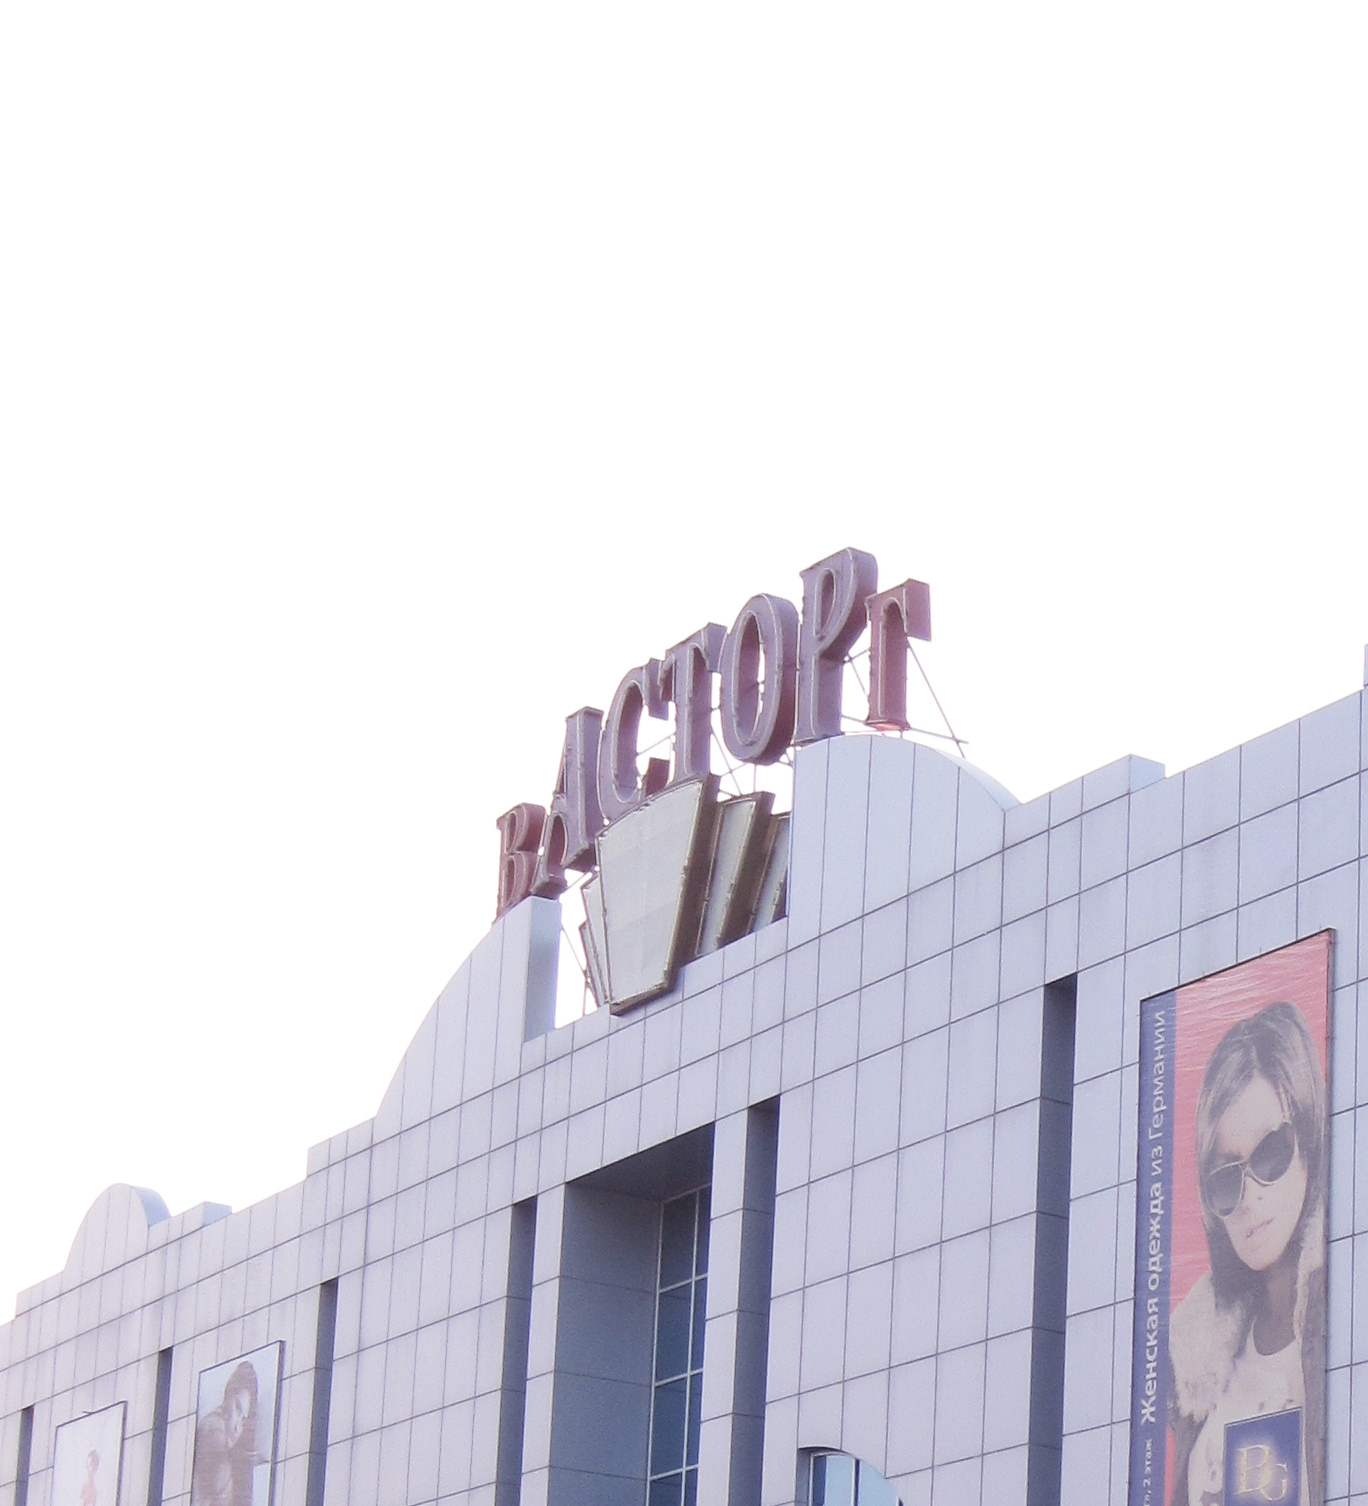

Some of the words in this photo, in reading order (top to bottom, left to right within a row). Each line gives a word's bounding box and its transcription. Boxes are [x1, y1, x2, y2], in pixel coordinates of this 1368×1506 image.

[1148, 1010, 1166, 1141] Германии
[1150, 1144, 1165, 1177] из
[1147, 1179, 1164, 1292] одежда
[1140, 1297, 1160, 1424] Женская
